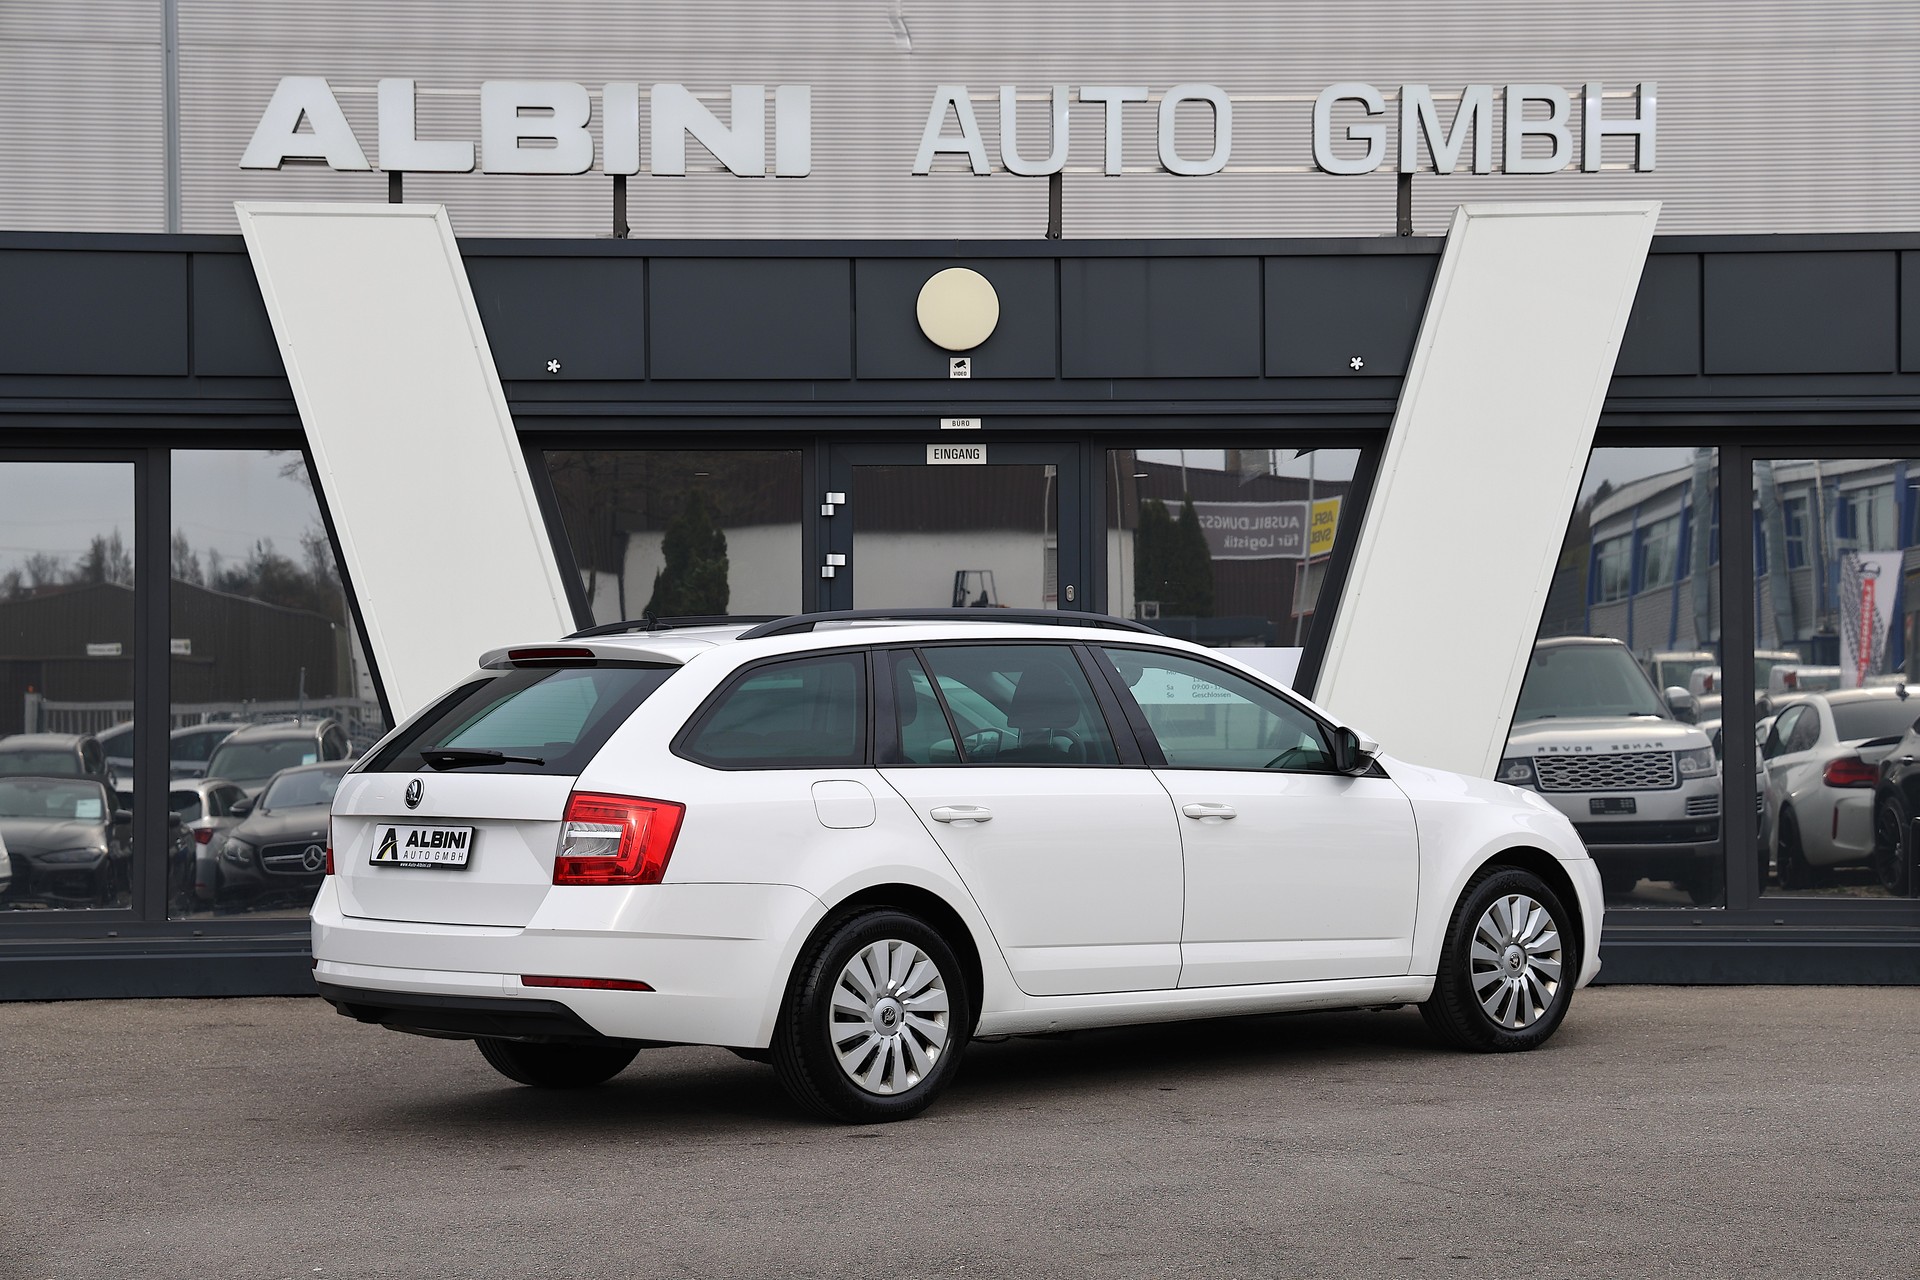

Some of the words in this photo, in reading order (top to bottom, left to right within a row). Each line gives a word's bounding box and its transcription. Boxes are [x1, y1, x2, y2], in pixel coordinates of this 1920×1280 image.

[238, 76, 812, 178] ALBINI
[911, 83, 1233, 177] AUTO
[1311, 81, 1658, 176] GMBH
[951, 419, 971, 427] BÜRO
[933, 448, 981, 460] EINGANG
[405, 830, 468, 848] ALBINI
[403, 850, 431, 860] AUTO
[434, 851, 464, 861] GMBH
